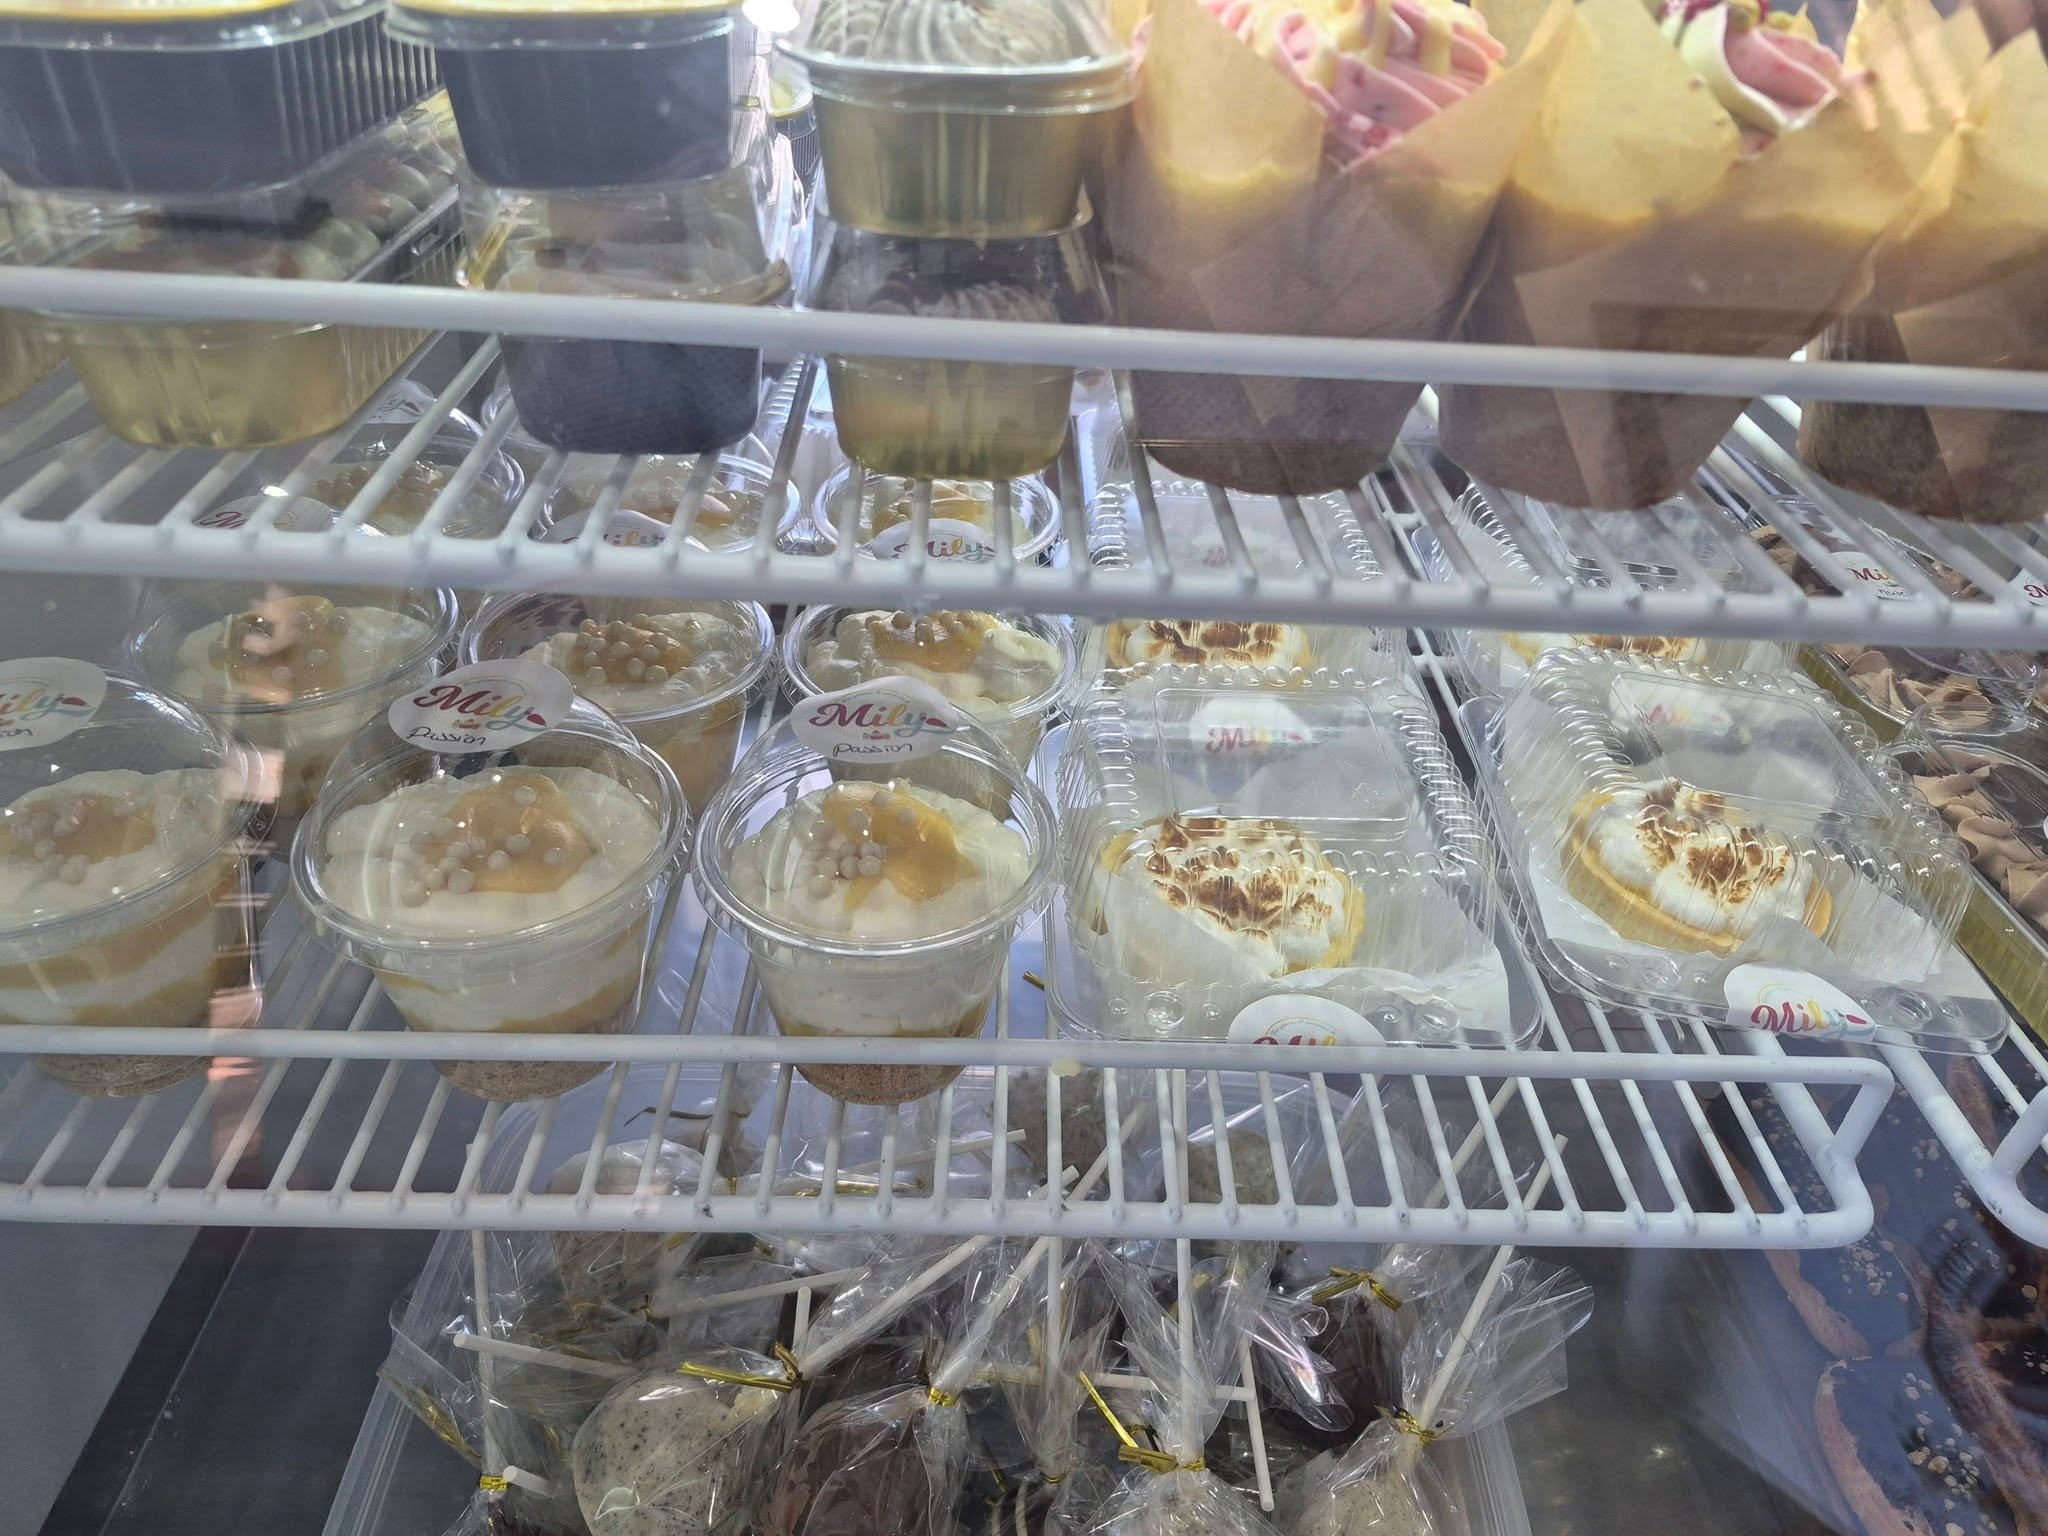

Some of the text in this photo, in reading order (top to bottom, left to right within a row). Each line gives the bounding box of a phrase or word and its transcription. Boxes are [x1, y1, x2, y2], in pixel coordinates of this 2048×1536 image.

[0, 688, 95, 720] ily
[413, 685, 547, 732] Mily
[808, 703, 954, 738] Mily
[1750, 1001, 1875, 1040] Mily
